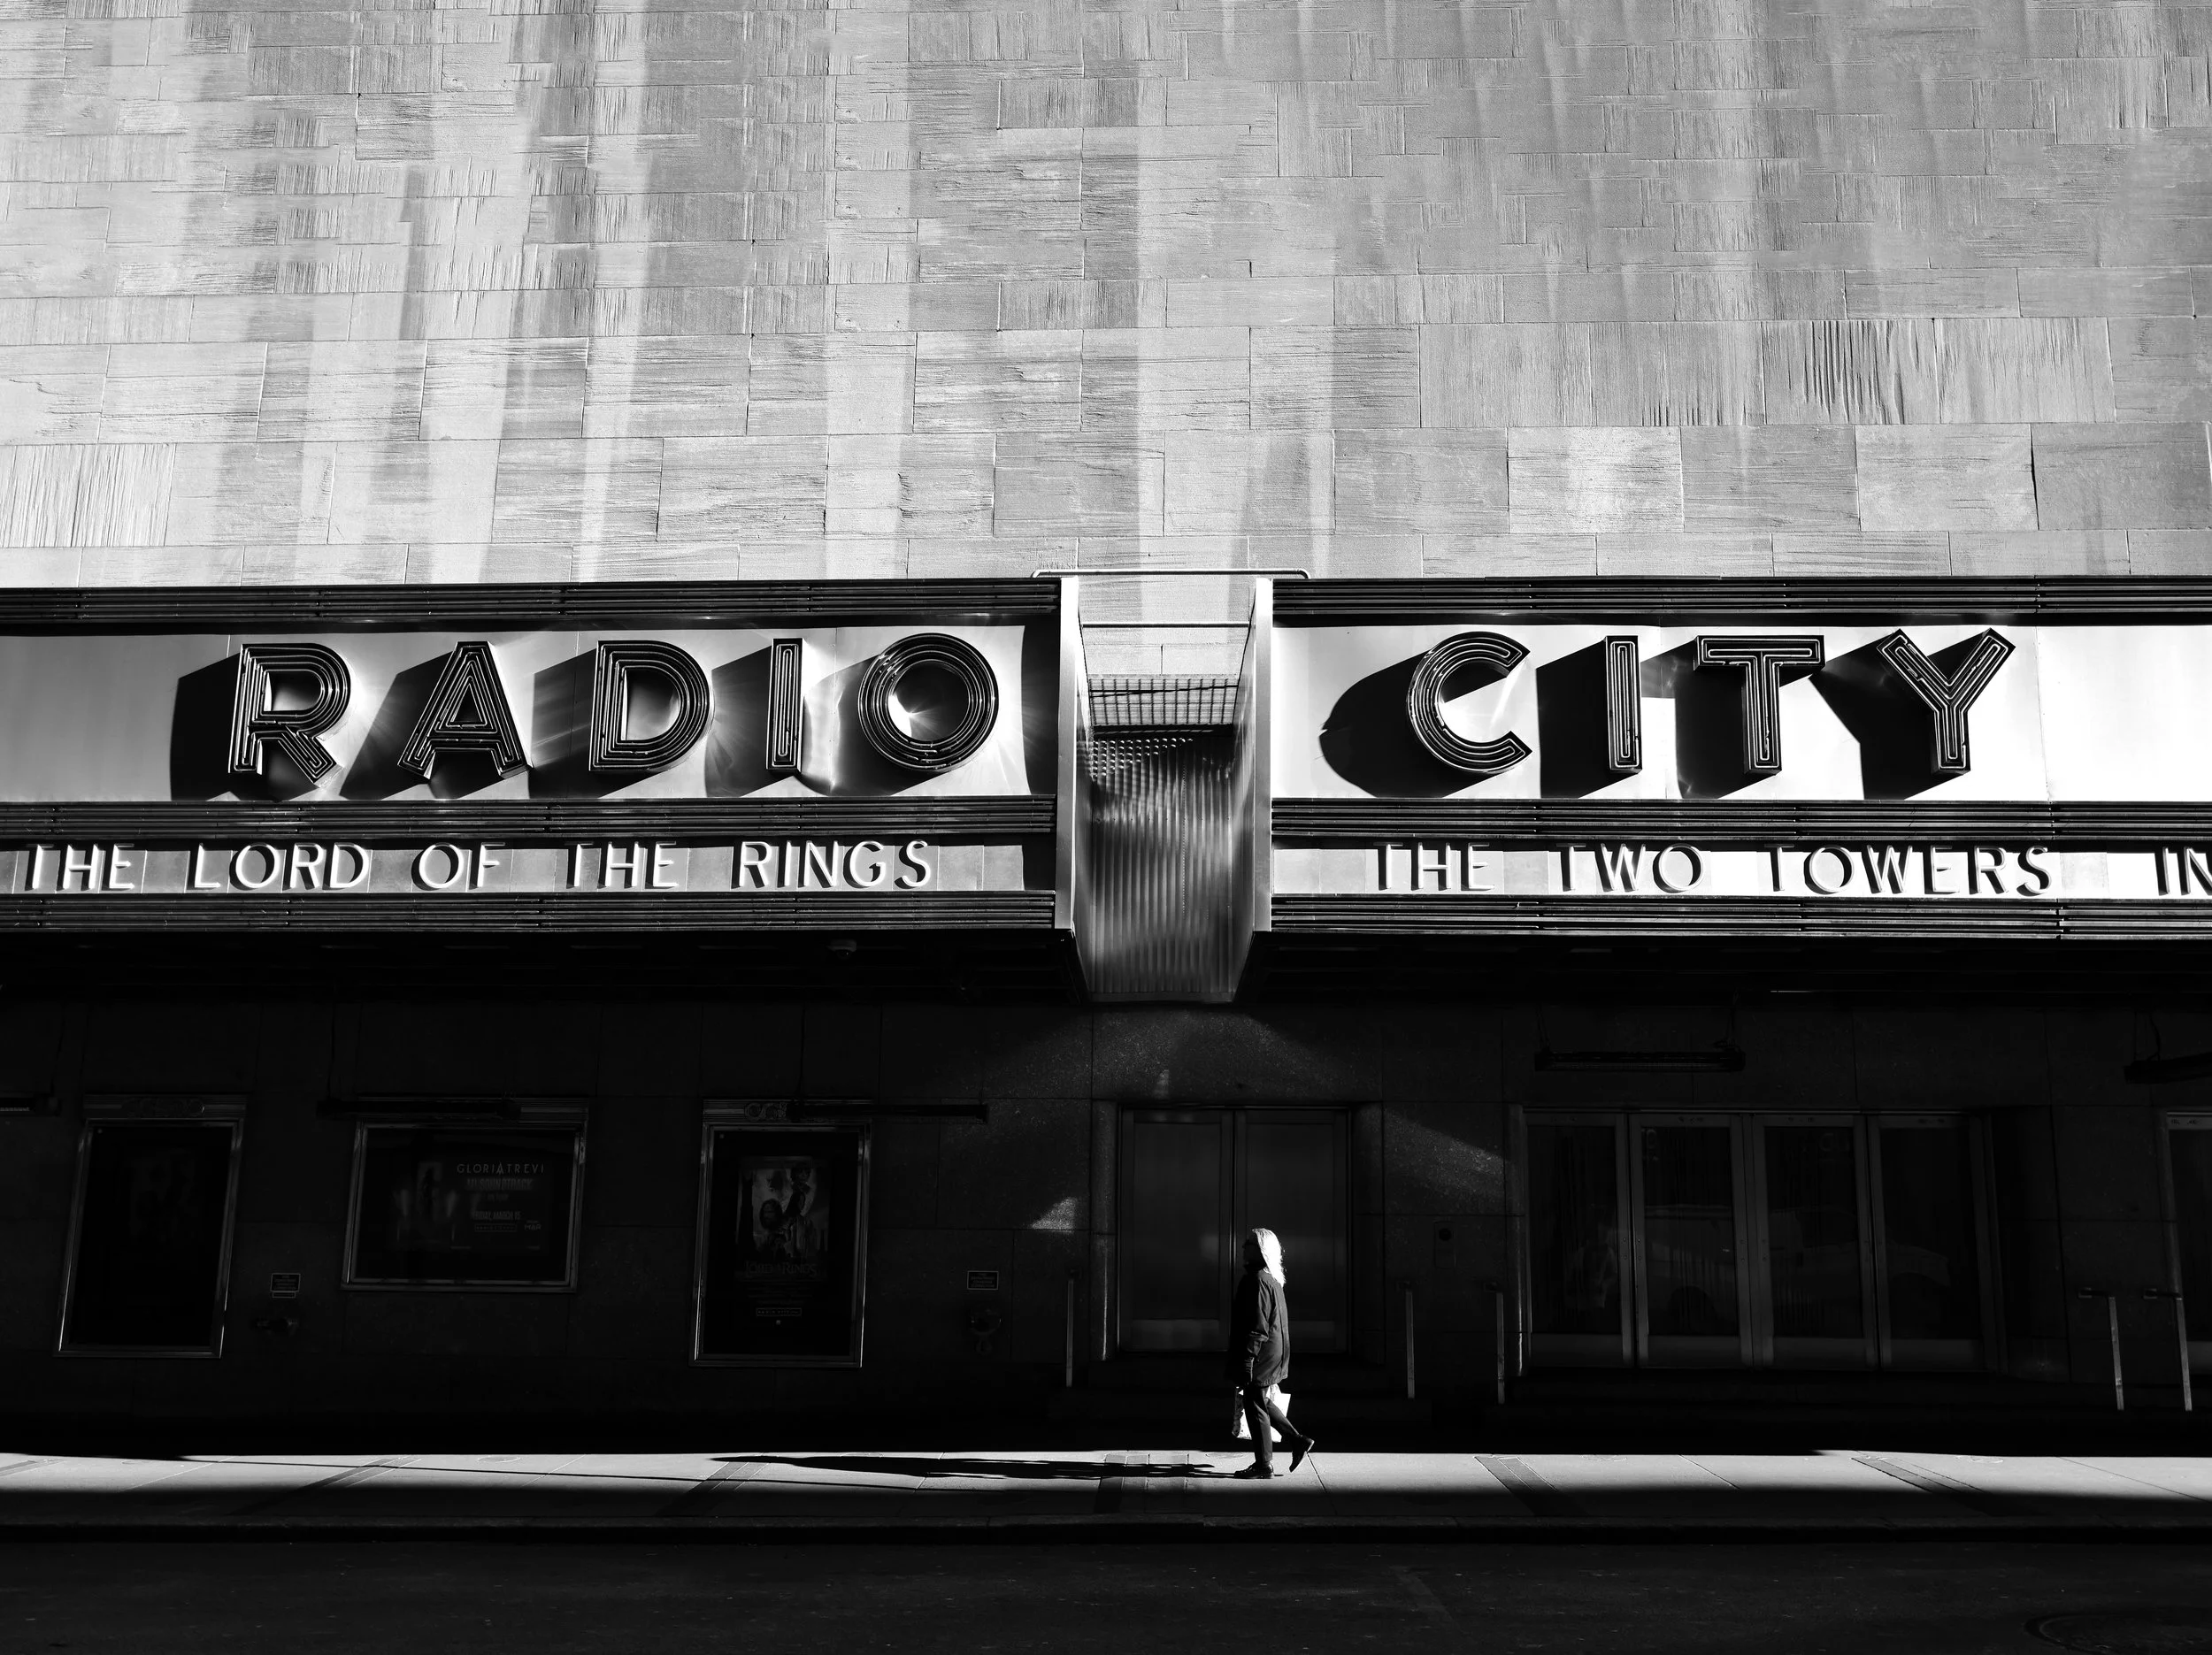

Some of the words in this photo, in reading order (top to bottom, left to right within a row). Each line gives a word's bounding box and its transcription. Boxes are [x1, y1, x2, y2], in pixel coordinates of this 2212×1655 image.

[227, 632, 999, 789] RADIO
[1407, 627, 2016, 776] CITY
[27, 842, 135, 890] THE
[192, 842, 370, 890] LORD
[417, 842, 506, 890] OF
[565, 839, 680, 888] THE
[737, 839, 932, 888] RINGS
[1372, 841, 1495, 891] THE
[1555, 842, 1706, 892] TWO
[1763, 843, 2051, 894] TOWERS
